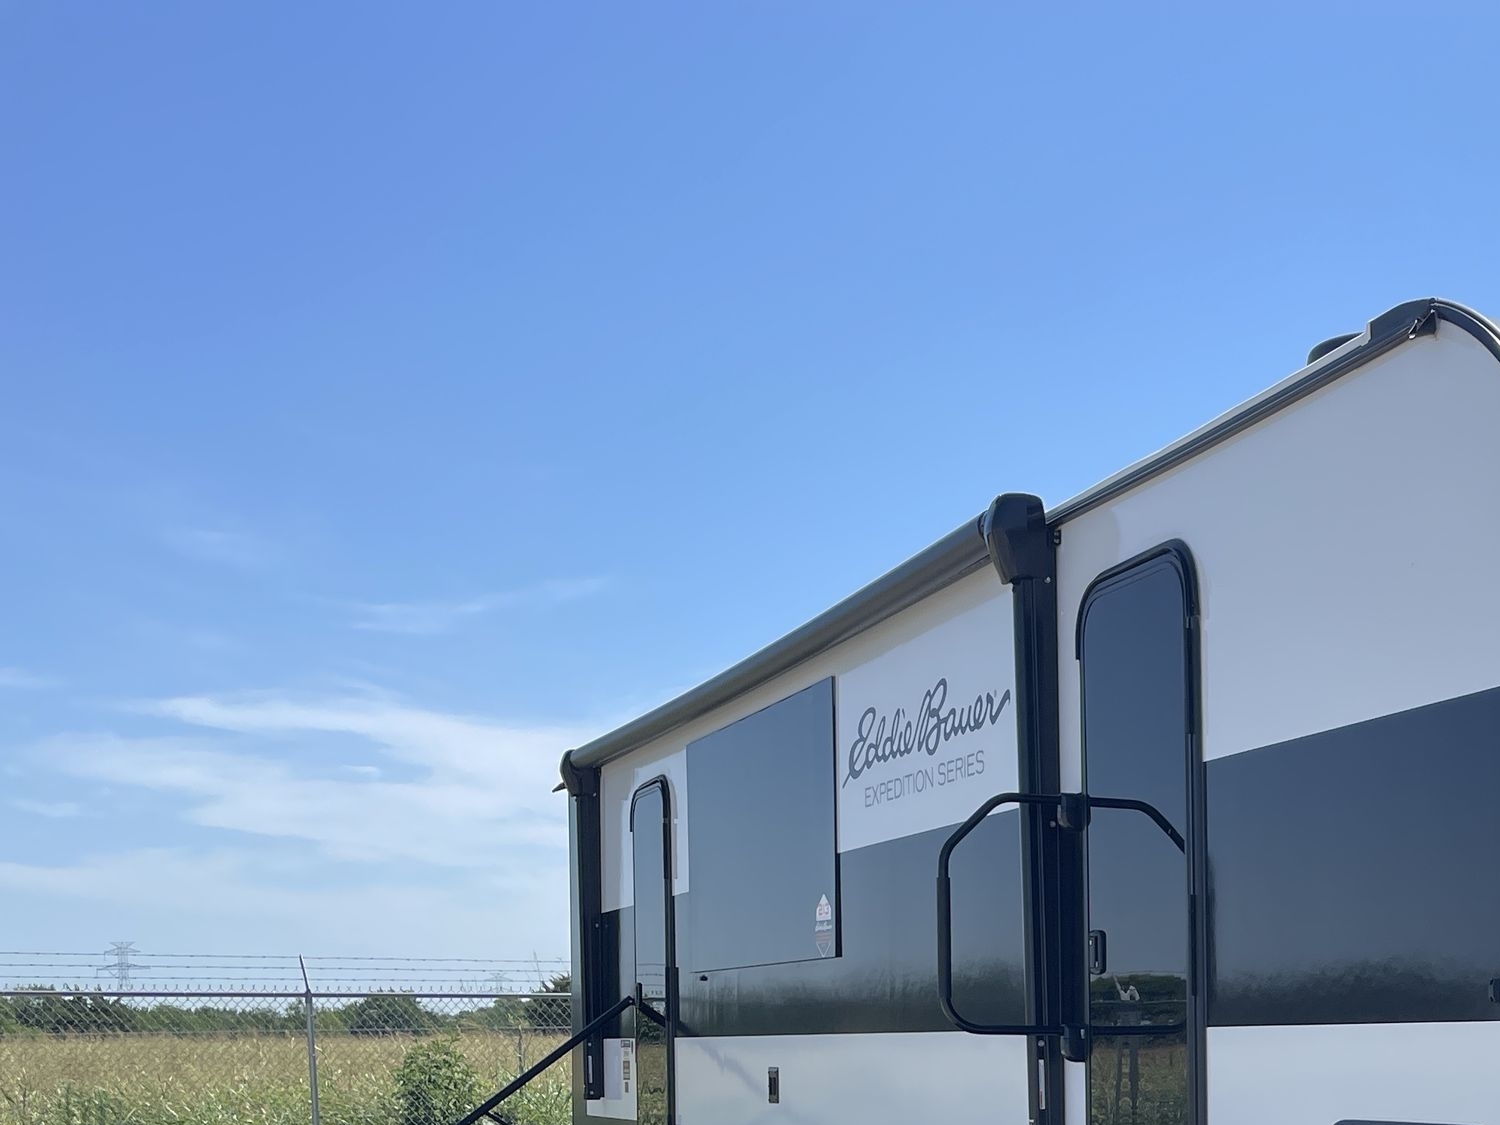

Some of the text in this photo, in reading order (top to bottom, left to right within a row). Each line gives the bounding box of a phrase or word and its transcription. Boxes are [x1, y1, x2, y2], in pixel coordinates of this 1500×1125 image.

[842, 677, 1011, 789] Eddie Bauer
[864, 750, 985, 808] EXPEDITION SERIES
